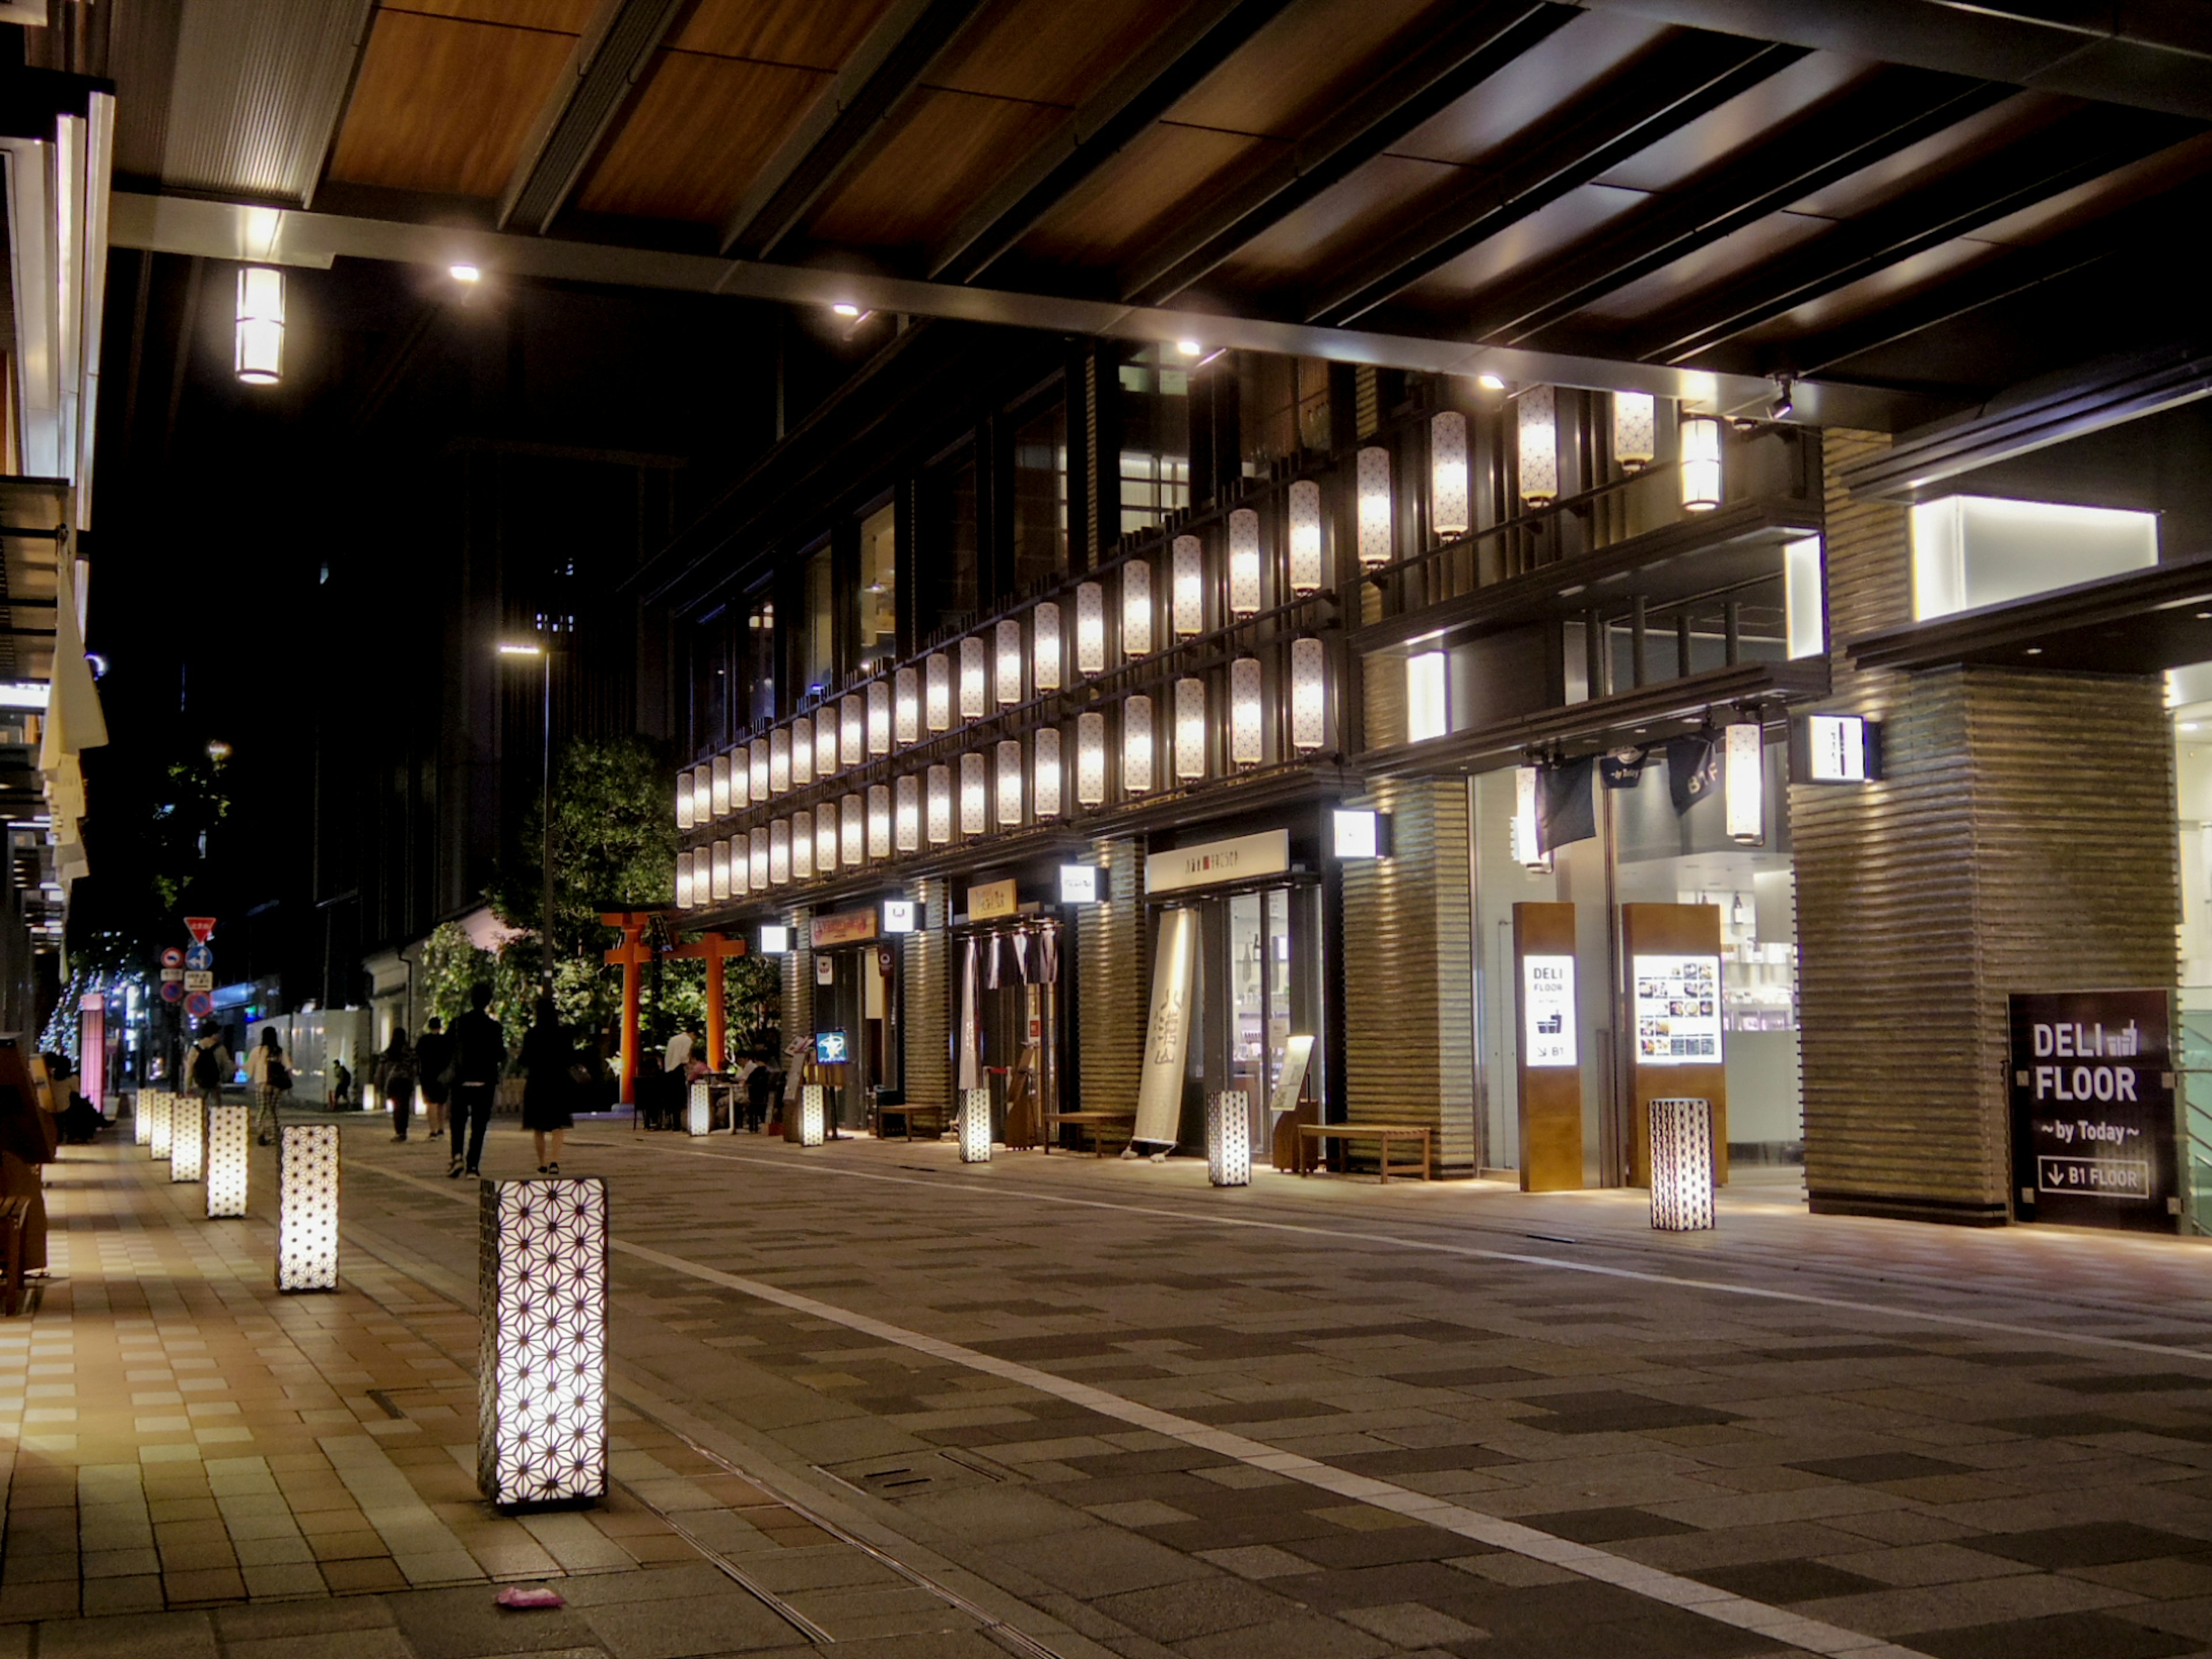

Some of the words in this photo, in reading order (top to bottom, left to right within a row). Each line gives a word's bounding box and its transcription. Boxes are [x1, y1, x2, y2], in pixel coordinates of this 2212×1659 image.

[1533, 967, 1563, 980] DELI
[1533, 983, 1563, 991] FLOOR
[2033, 1022, 2102, 1058] DELI
[1552, 1047, 1564, 1056] B1
[2036, 1066, 2138, 1102] FLOOR
[2068, 1166, 2085, 1185] B1
[2089, 1168, 2138, 1188] FLOOR
